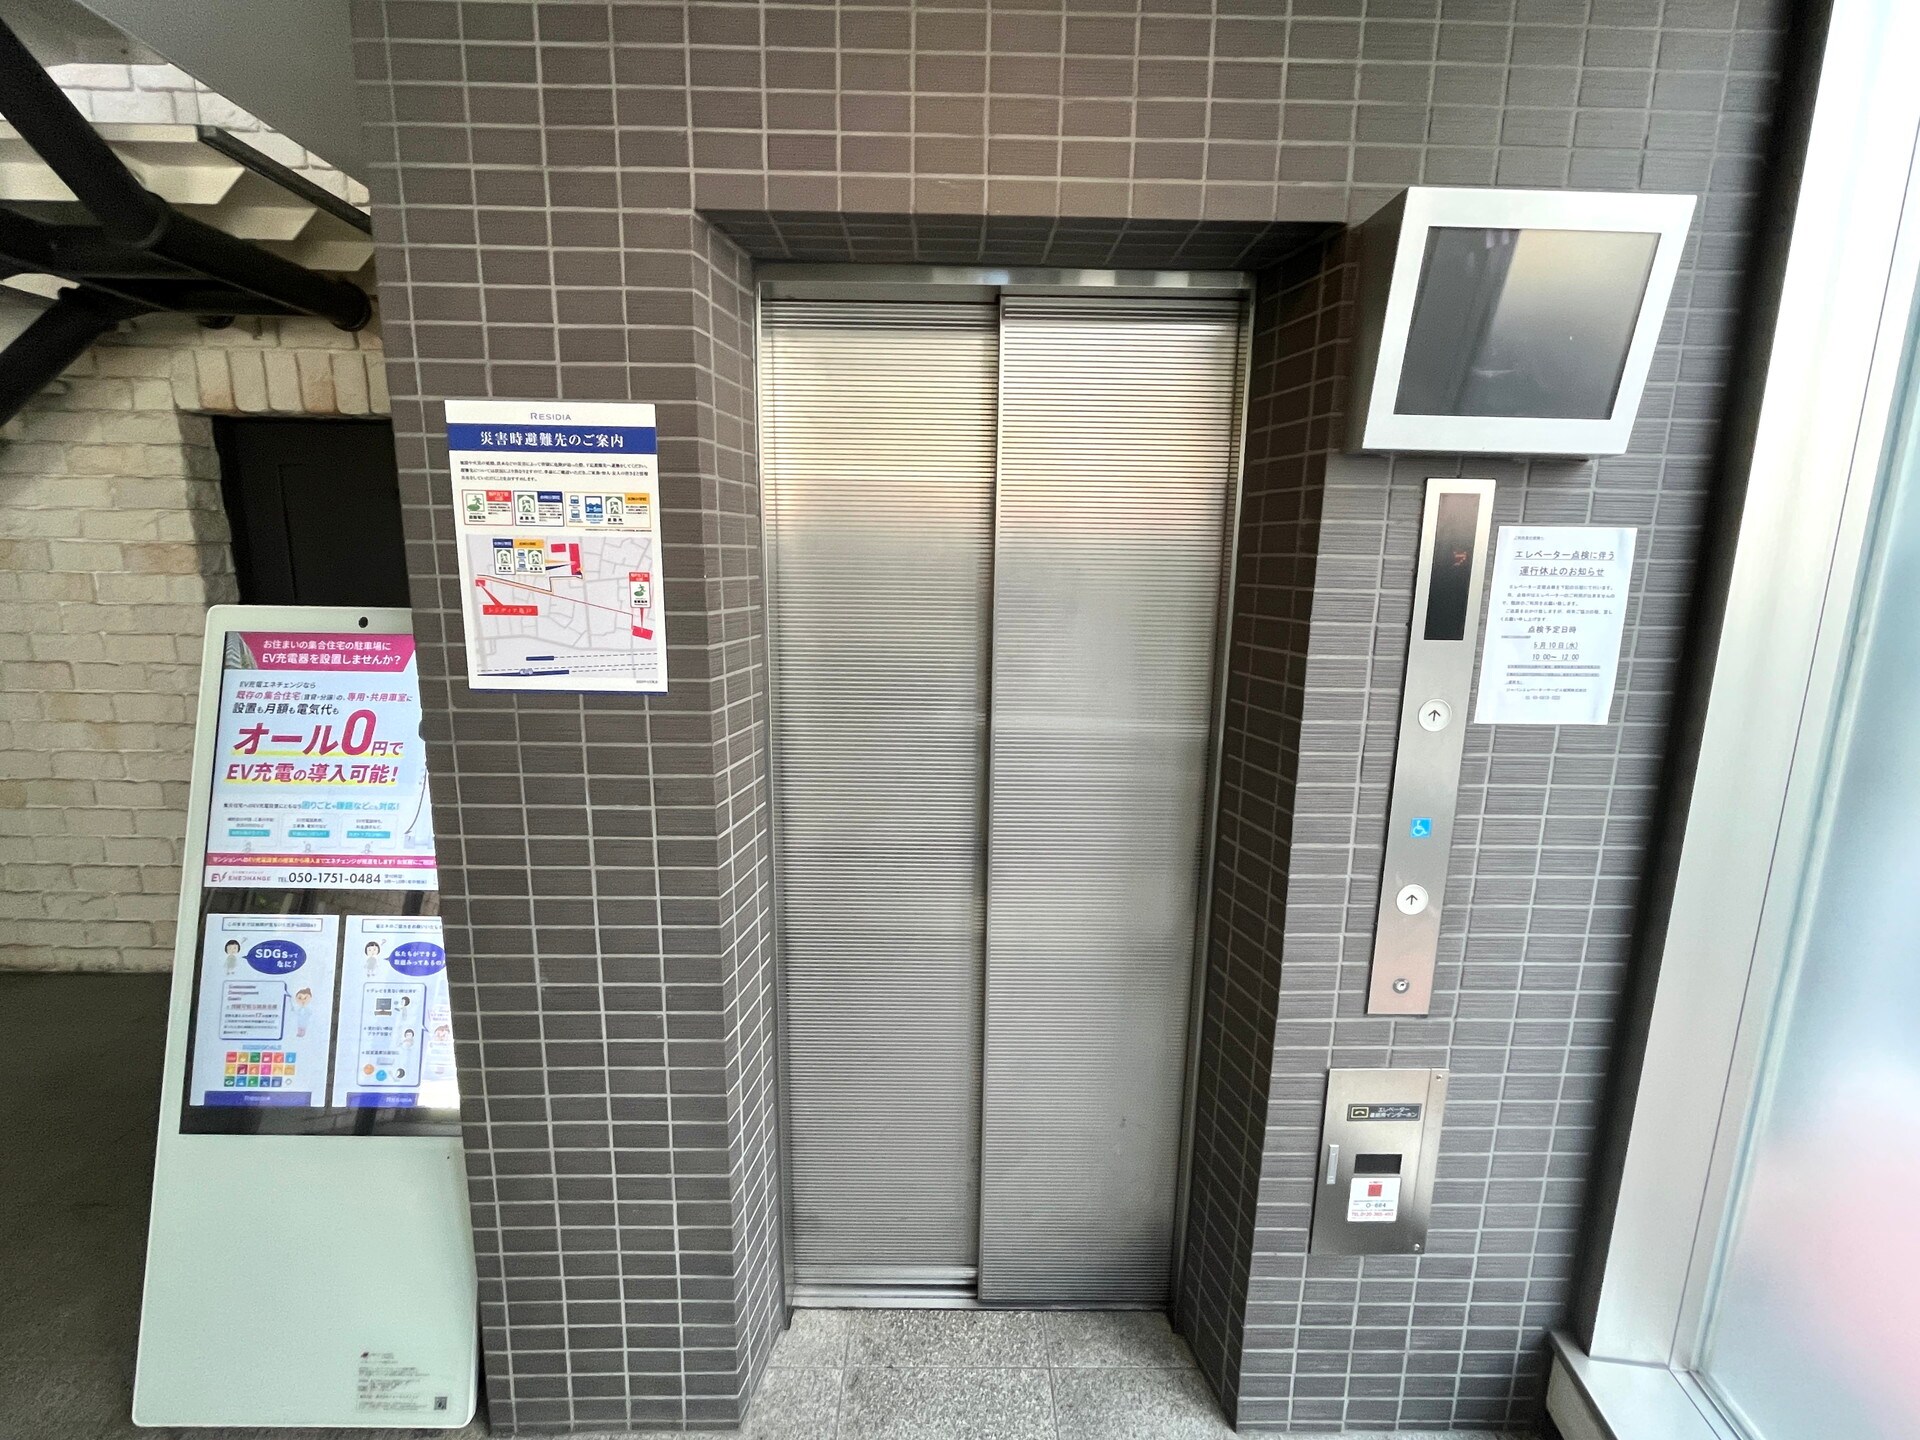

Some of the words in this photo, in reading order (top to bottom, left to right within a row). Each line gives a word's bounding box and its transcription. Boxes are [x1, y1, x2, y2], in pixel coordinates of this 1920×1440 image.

[480, 431, 624, 448] 災害時避難先のご案内
[1514, 550, 1616, 560] エレベーター点検に伴う
[1519, 566, 1605, 576] 運行休止のお知らせ
[1528, 625, 1577, 634] 点検予定日時
[263, 640, 392, 651] お住まいの集合住宅の駐車場に
[239, 681, 317, 689] EV充電エネチェンジなら
[232, 702, 340, 715] 設置も月額も電気代も
[233, 709, 404, 756] オール0円で
[394, 950, 438, 958] 私たちができる
